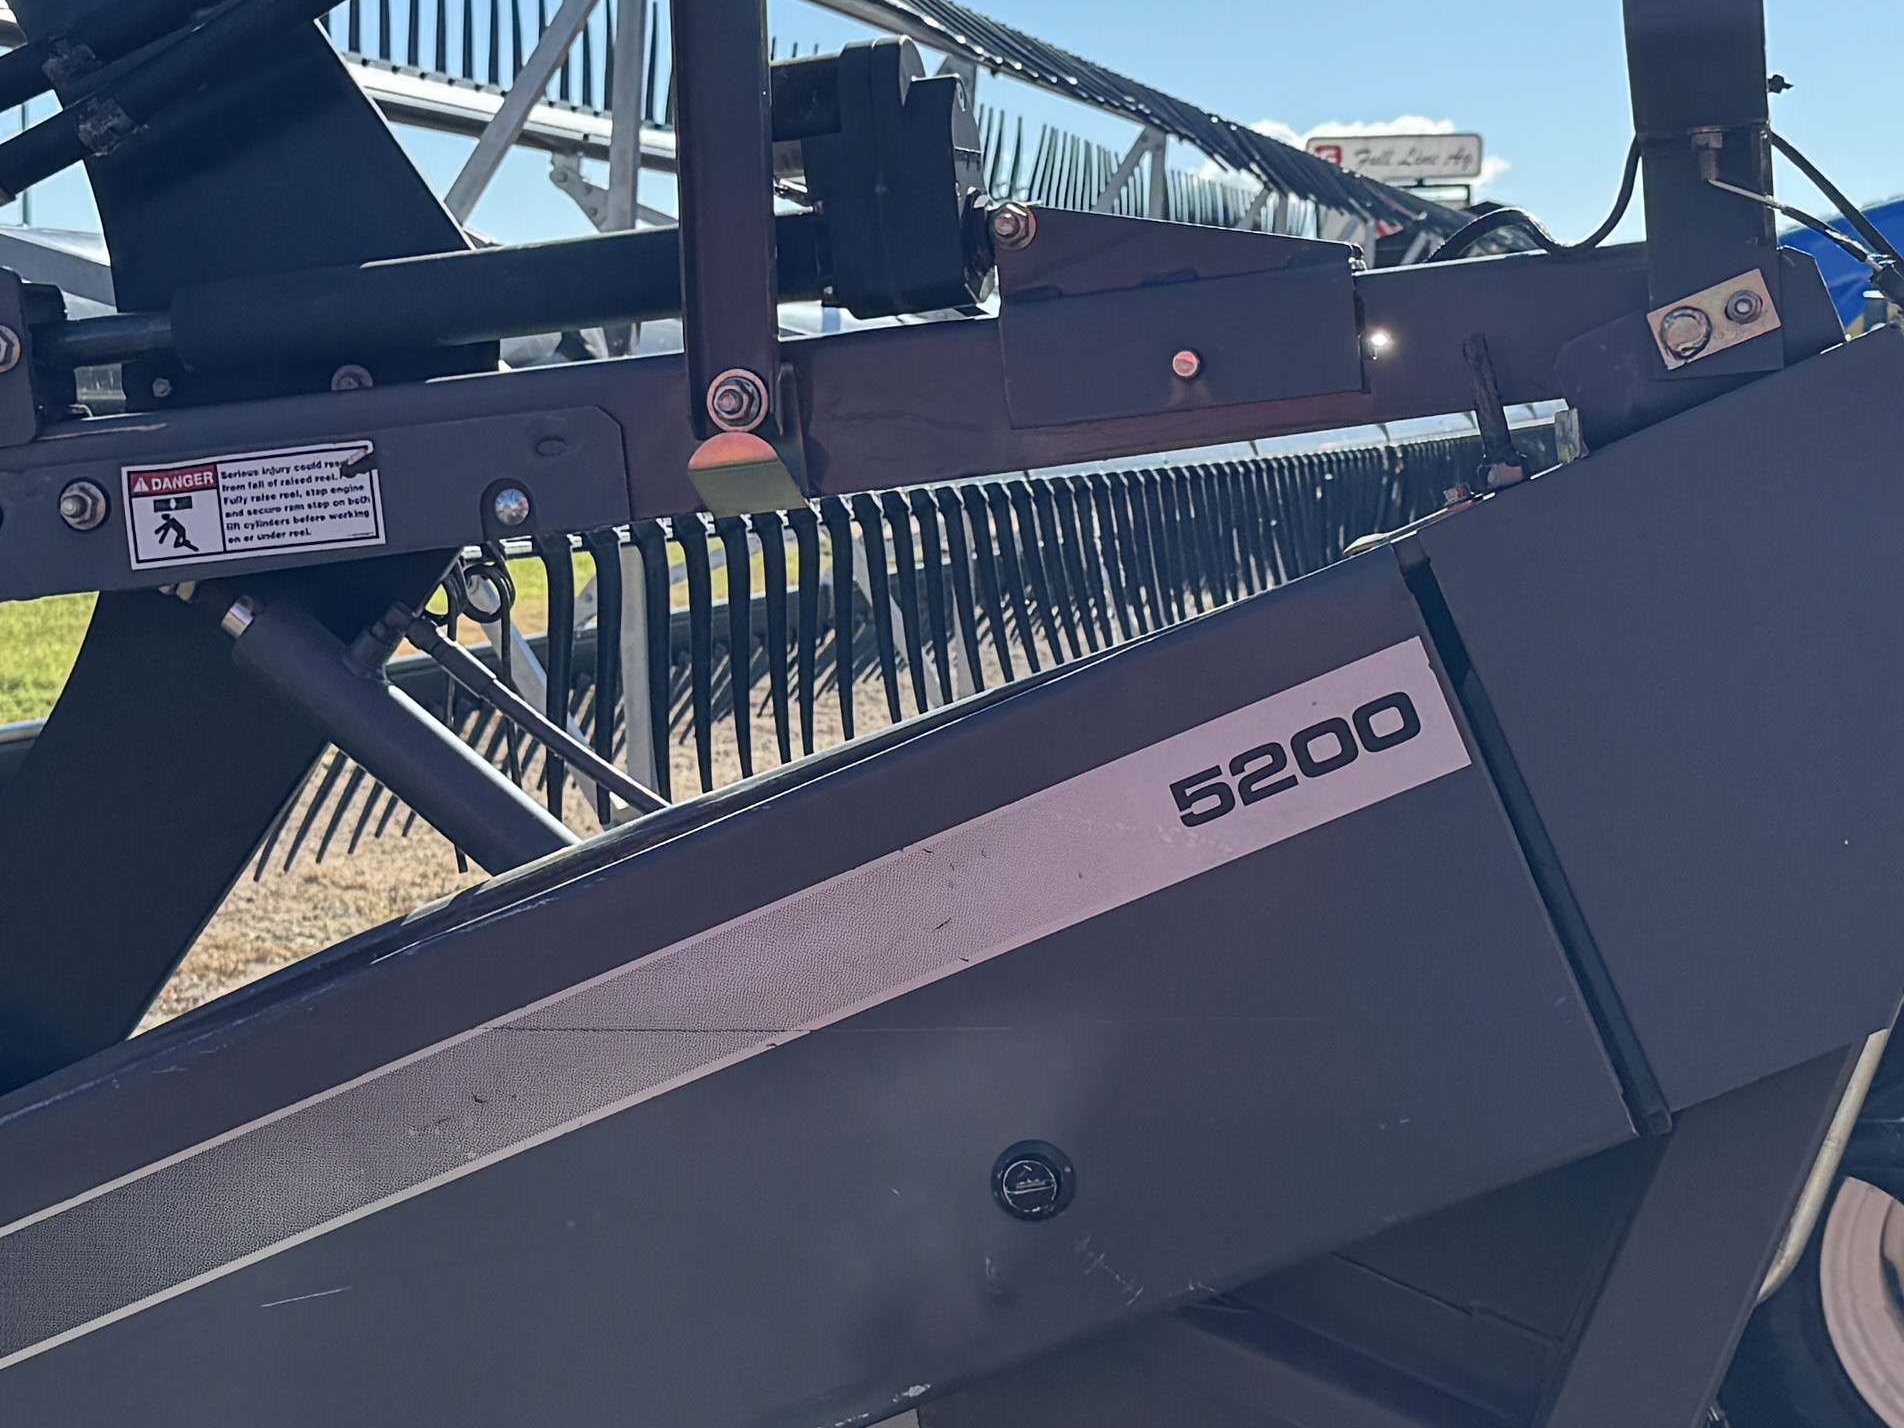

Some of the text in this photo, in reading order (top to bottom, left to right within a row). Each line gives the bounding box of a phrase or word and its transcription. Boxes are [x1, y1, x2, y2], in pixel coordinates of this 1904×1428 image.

[221, 468, 259, 479] Serious
[262, 464, 291, 477] injury
[293, 461, 322, 472] could
[151, 472, 213, 491] DANGER
[222, 473, 338, 492] from fall of raised reel.
[224, 484, 364, 507] Fully raise reel, stop engine
[225, 509, 244, 518] and
[247, 506, 281, 516] secure
[284, 503, 304, 512] ram
[307, 500, 329, 510] stop
[348, 495, 370, 505] both
[226, 508, 369, 531] lift cylinders before working
[257, 529, 286, 540] under
[289, 528, 311, 537] reel.
[1169, 691, 1421, 828] 5200
